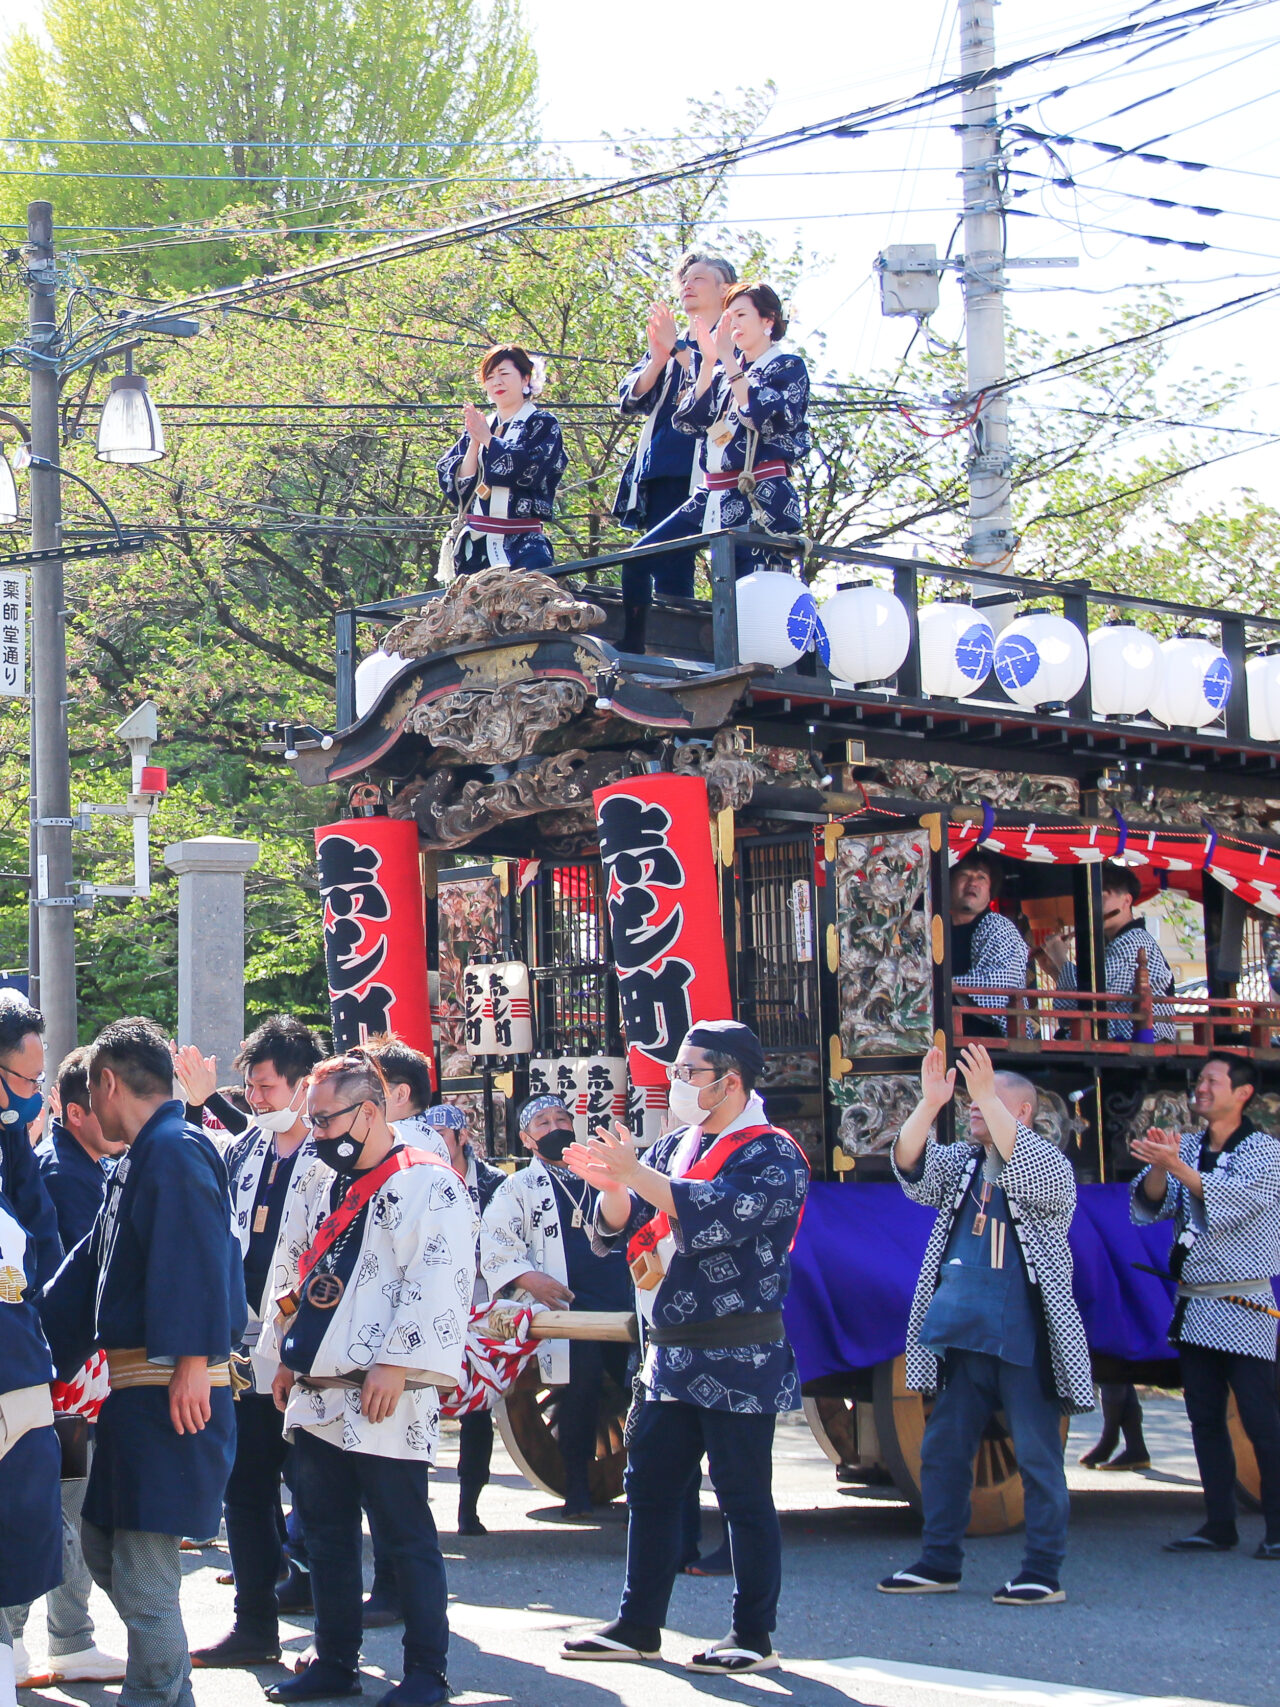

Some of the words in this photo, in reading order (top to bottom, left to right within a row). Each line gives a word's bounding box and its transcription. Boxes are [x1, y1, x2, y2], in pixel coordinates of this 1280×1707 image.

[3, 580, 20, 686] 薬師堂通り
